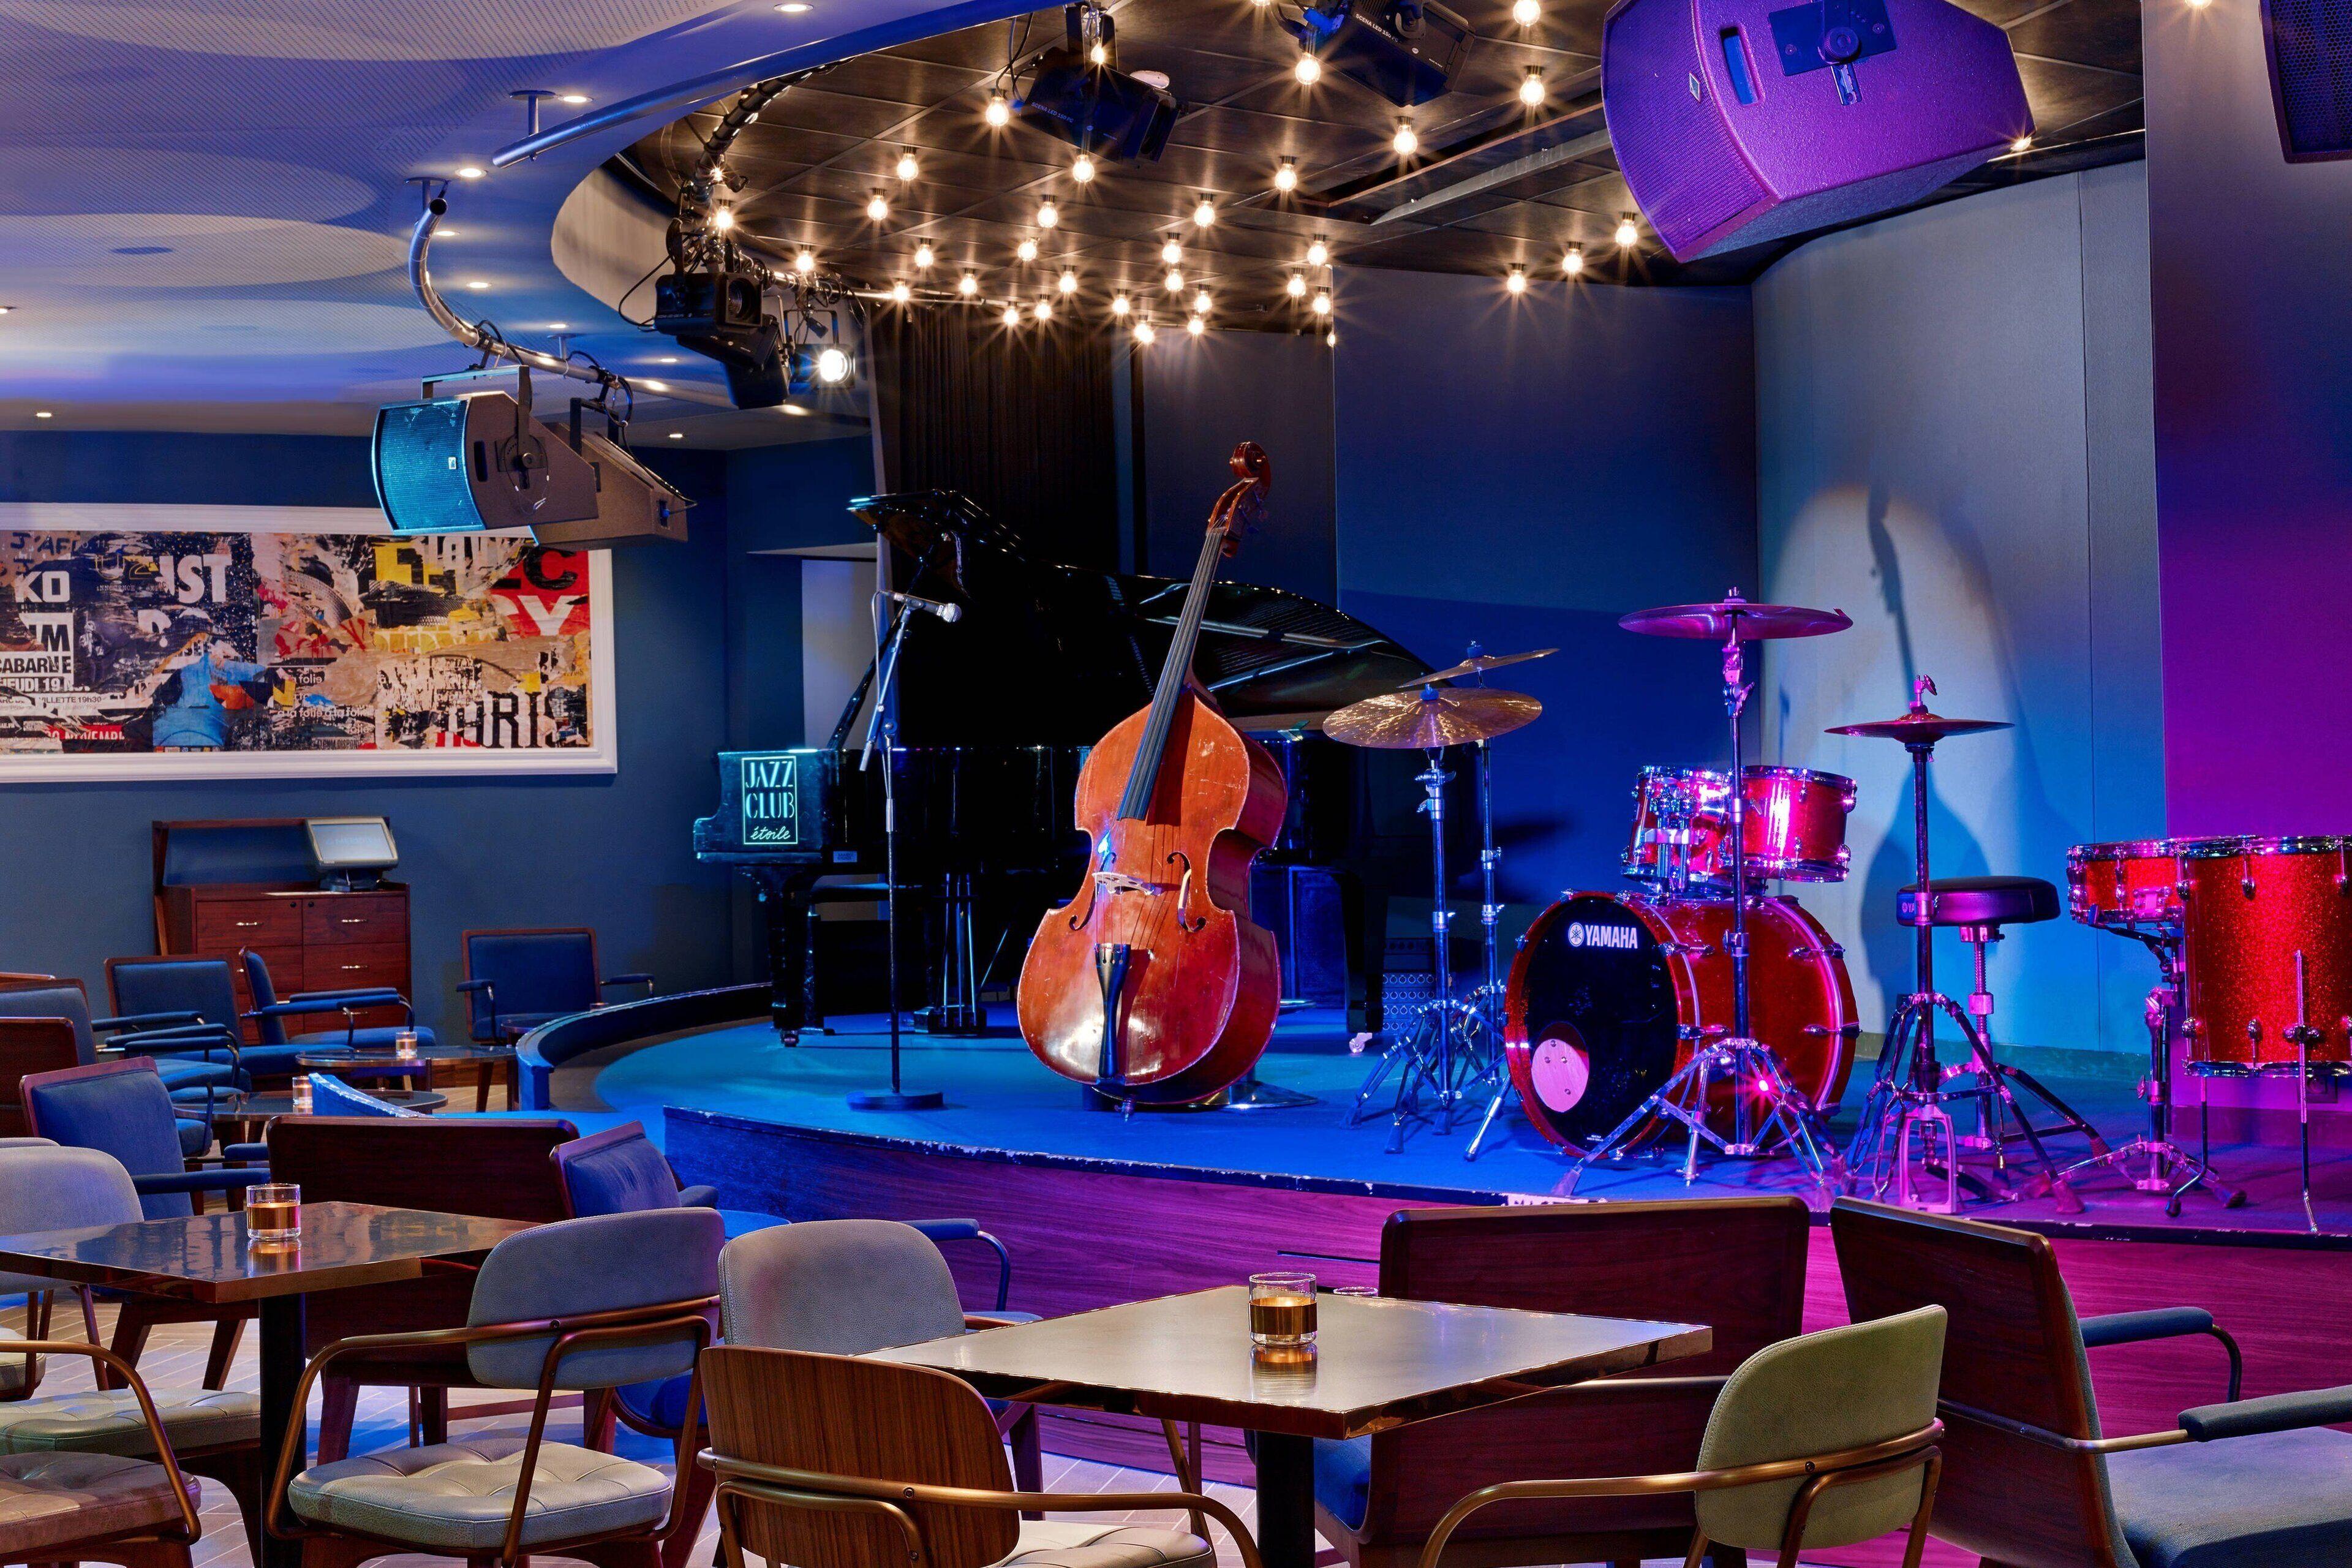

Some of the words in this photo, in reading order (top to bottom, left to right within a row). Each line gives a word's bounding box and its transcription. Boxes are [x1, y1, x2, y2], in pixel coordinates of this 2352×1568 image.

[1355, 13, 1372, 26] SCENA
[1372, 23, 1382, 32] LED
[1031, 102, 1047, 112] SCENA
[745, 761, 794, 788] JAZZ
[745, 792, 794, 818] CLUB
[750, 826, 791, 840] étoile
[1585, 924, 1638, 949] YAMAHA
